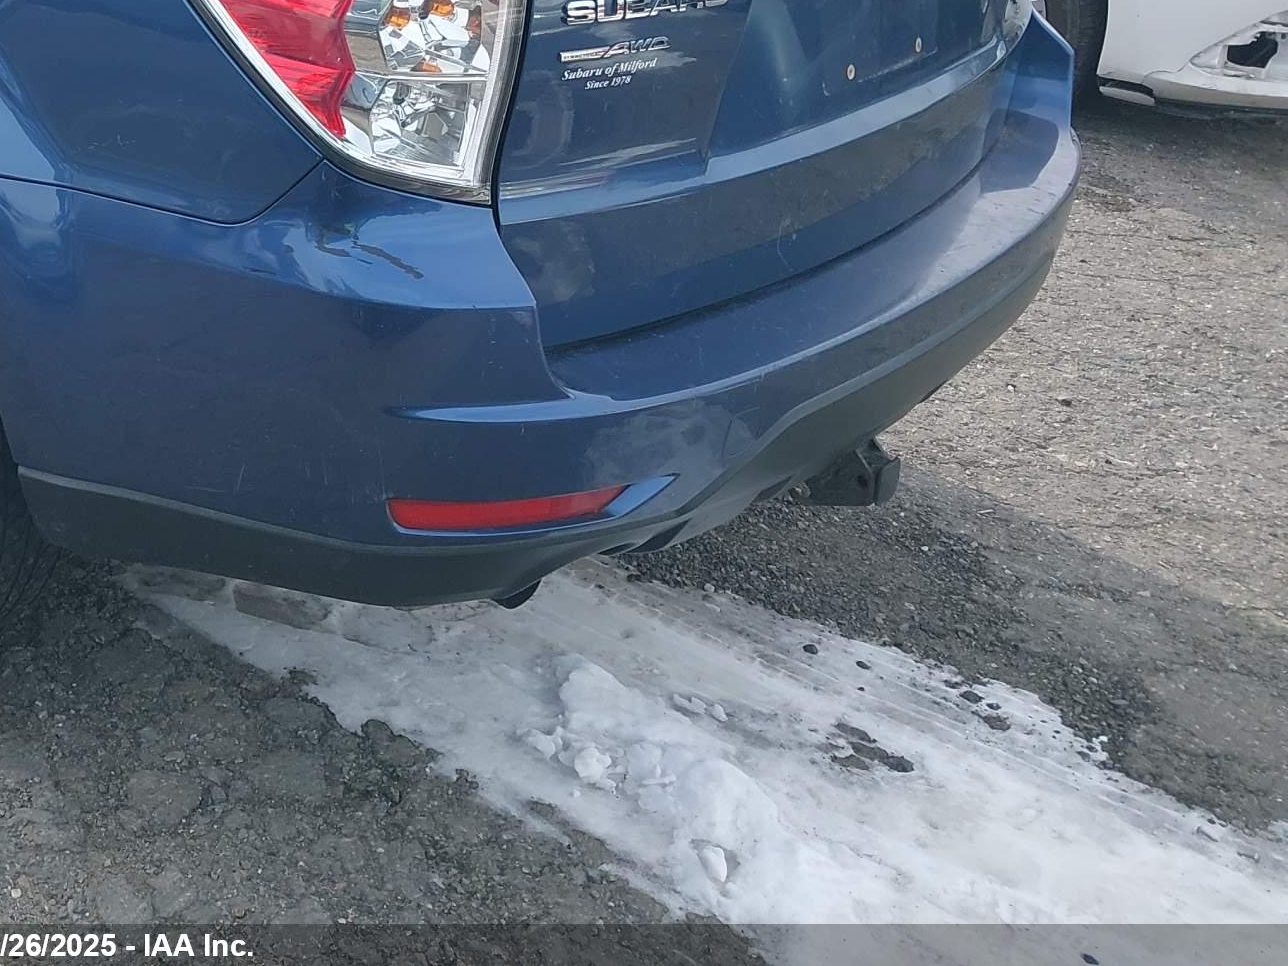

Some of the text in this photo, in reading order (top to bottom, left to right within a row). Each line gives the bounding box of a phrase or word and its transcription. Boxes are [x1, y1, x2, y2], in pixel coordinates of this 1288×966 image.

[602, 36, 671, 59] AWD
[561, 58, 658, 81] Subaru of Milford
[585, 75, 632, 90] Since 1978
